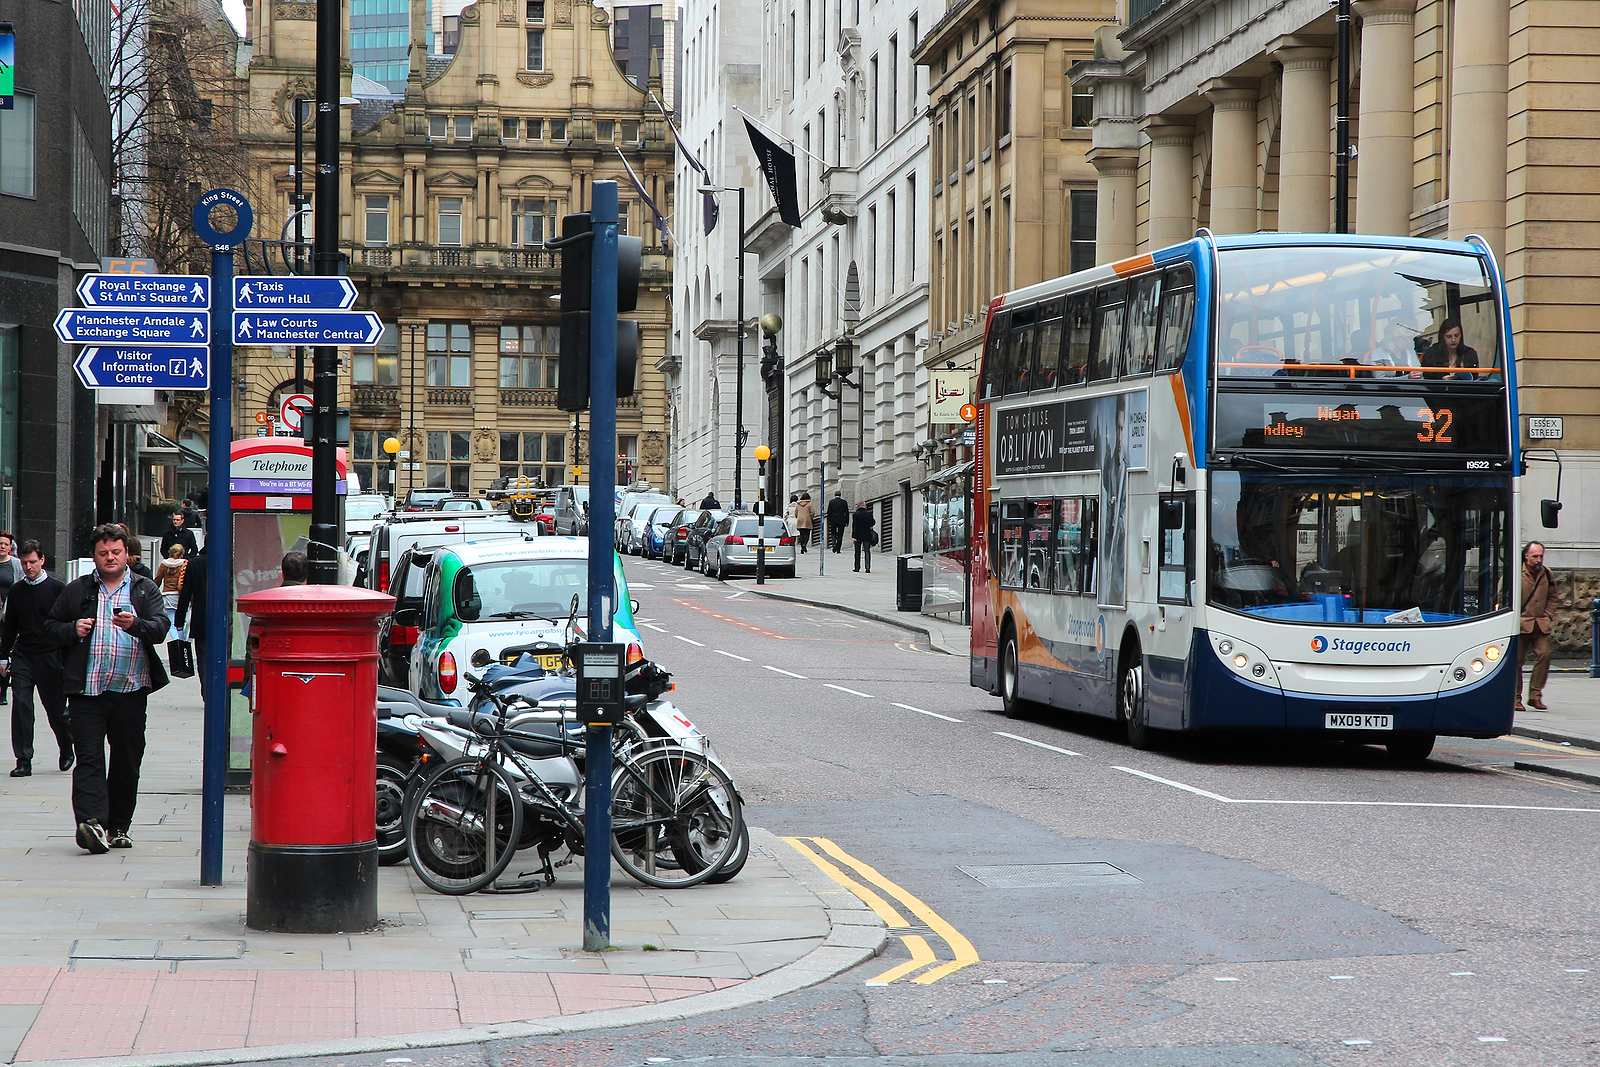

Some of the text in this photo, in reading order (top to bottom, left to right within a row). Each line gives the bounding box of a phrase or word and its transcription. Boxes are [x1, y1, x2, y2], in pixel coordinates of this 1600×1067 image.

[202, 191, 244, 207] King Street
[100, 280, 186, 292] Royal Exchange
[257, 281, 284, 291] Taxis
[100, 292, 188, 304] St Ann's Square
[256, 294, 311, 304] Town Hall
[76, 315, 186, 326] Manchester Arndale
[257, 318, 318, 328] Law Courts
[76, 327, 171, 338] Exchange Square
[257, 330, 364, 340] Manchester Central
[116, 350, 152, 360] Visitor
[102, 361, 166, 372] Information
[115, 374, 153, 383] Centre
[965, 407, 973, 418] 1
[1317, 406, 1361, 421] Wigan
[1006, 415, 1019, 431] TOM
[1022, 410, 1049, 427] CRUISE
[1416, 408, 1453, 443] 32
[1534, 419, 1557, 428] ESSEX
[1530, 428, 1561, 438] STREET
[1000, 429, 1054, 463] OBLIVION
[251, 460, 308, 473] Telephone
[1466, 461, 1490, 469] 19522
[477, 548, 586, 559] www.lycamobile.co.uk
[1068, 613, 1096, 642] Stagecoach
[1331, 637, 1411, 654] Stagecoach
[672, 714, 692, 728] L
[1330, 715, 1388, 727] MX09 KTD
